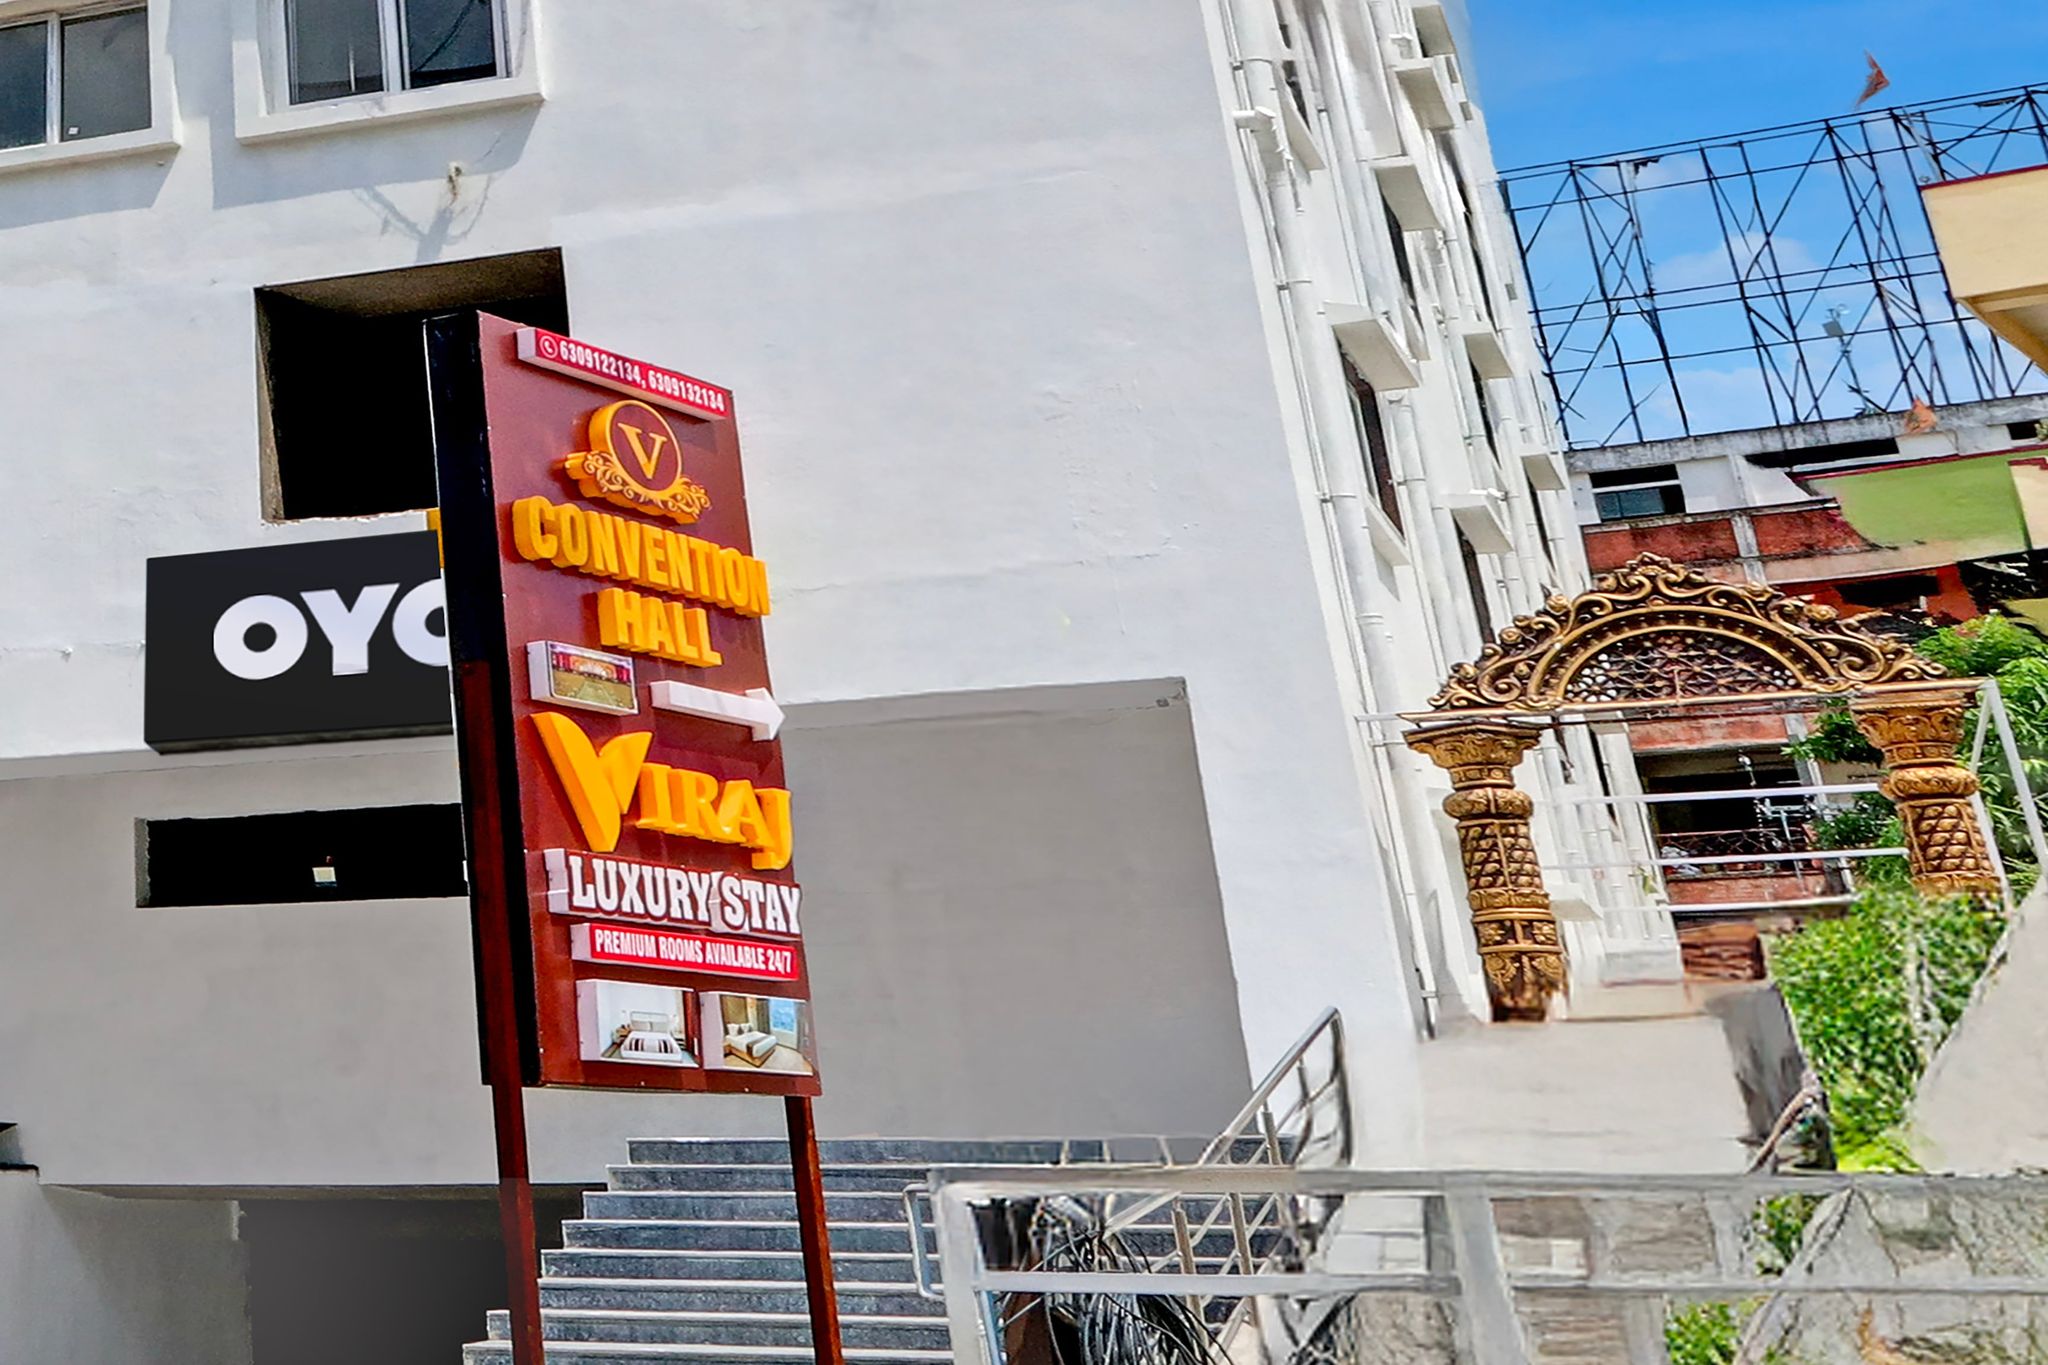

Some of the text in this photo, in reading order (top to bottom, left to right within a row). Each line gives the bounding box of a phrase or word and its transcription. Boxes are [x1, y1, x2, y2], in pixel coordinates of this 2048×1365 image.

[559, 340, 725, 412] 6309122134, 6309132134
[617, 422, 668, 480] V
[513, 495, 771, 617] CONVENTION
[598, 587, 723, 668] HALL
[531, 711, 793, 870] VIRAJ
[568, 855, 801, 935] LUXURY STAY
[594, 928, 792, 975] PREMIUM ROOMS AVAILABLE 24/7
